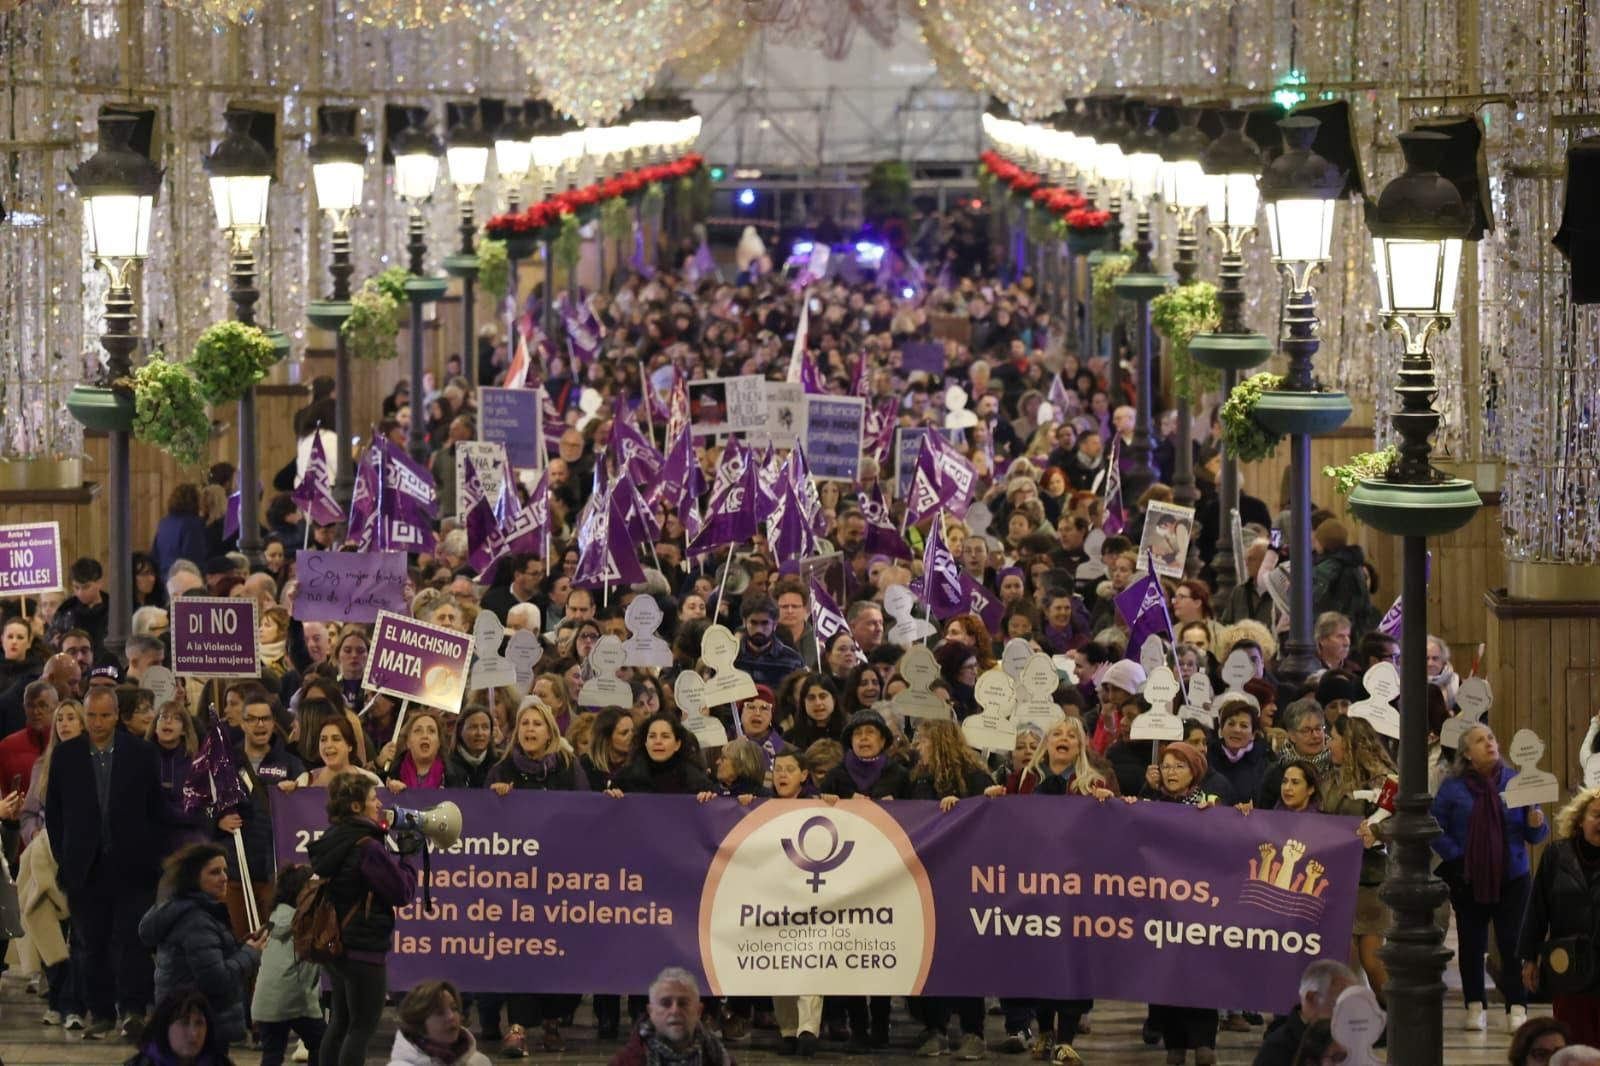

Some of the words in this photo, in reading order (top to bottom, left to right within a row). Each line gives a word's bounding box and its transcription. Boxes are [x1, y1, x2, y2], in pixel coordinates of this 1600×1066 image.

[9, 549, 34, 568] ¡NO
[307, 555, 340, 588] Soy
[10, 568, 51, 586] CALLES!
[189, 613, 203, 634] DI
[210, 608, 238, 634] NO
[186, 641, 193, 651] A
[194, 641, 202, 651] la
[203, 642, 243, 652] Violencia
[384, 624, 398, 642] EL
[399, 628, 462, 659] MACHISMO
[177, 655, 204, 664] contra
[205, 654, 218, 664] las
[218, 655, 254, 666] mujeres
[378, 647, 422, 679] MATA
[417, 866, 538, 889] nacional
[546, 871, 611, 896] para
[618, 868, 643, 892] la
[969, 864, 1006, 894] Ni
[1017, 871, 1081, 895] una
[1093, 871, 1220, 908] menos,
[392, 896, 458, 921] ción
[466, 898, 504, 922] de
[511, 898, 535, 923] la
[544, 899, 673, 926] violencia
[739, 904, 894, 927] Plataforma
[778, 927, 827, 940] contra
[831, 926, 851, 939] las
[968, 907, 1062, 938] Vivas
[1072, 914, 1134, 940] nos
[1143, 918, 1322, 956] queremos
[393, 930, 432, 954] las
[440, 933, 566, 960] mujeres.
[737, 938, 814, 953] violencias
[818, 937, 897, 952] machistas
[737, 954, 838, 970] VIOLENCIA
[845, 953, 898, 969] CERO
